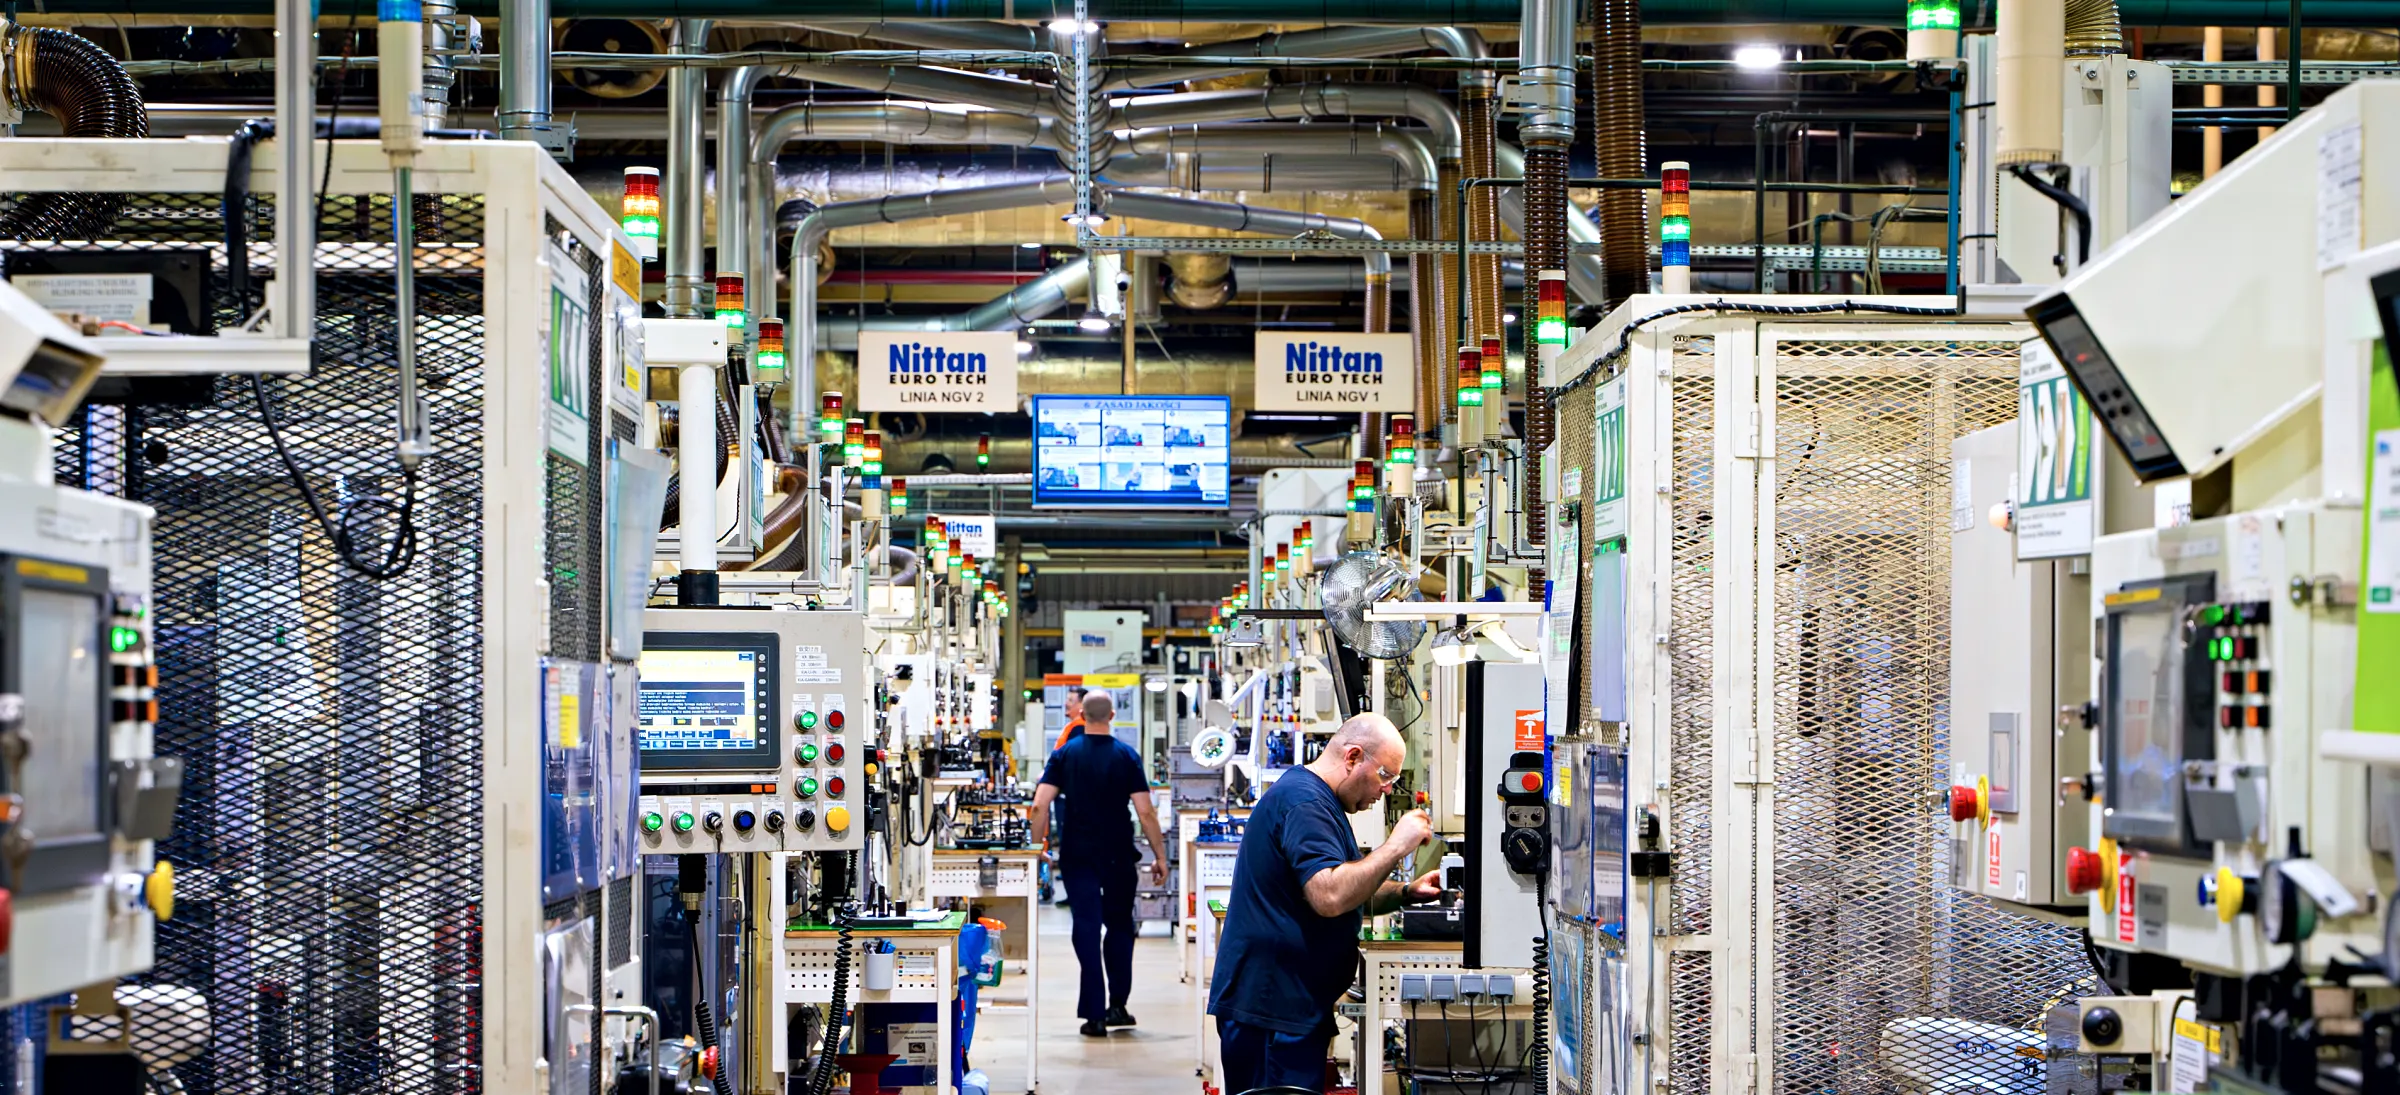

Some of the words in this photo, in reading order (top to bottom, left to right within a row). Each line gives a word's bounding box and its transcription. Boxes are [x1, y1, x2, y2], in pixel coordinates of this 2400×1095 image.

[890, 342, 986, 373] Nittan
[1286, 341, 1382, 372] Nittan
[890, 374, 937, 385] EURO
[945, 374, 986, 385] TECH
[1286, 373, 1332, 384] EURO
[1341, 373, 1382, 384] TECH
[900, 391, 937, 403] LINIA
[942, 391, 972, 403] NGV
[977, 391, 984, 403] 2
[1297, 391, 1333, 402] LINIA
[1338, 391, 1368, 402] NGV
[1373, 391, 1379, 402] 1
[1095, 401, 1133, 409] ZASAD
